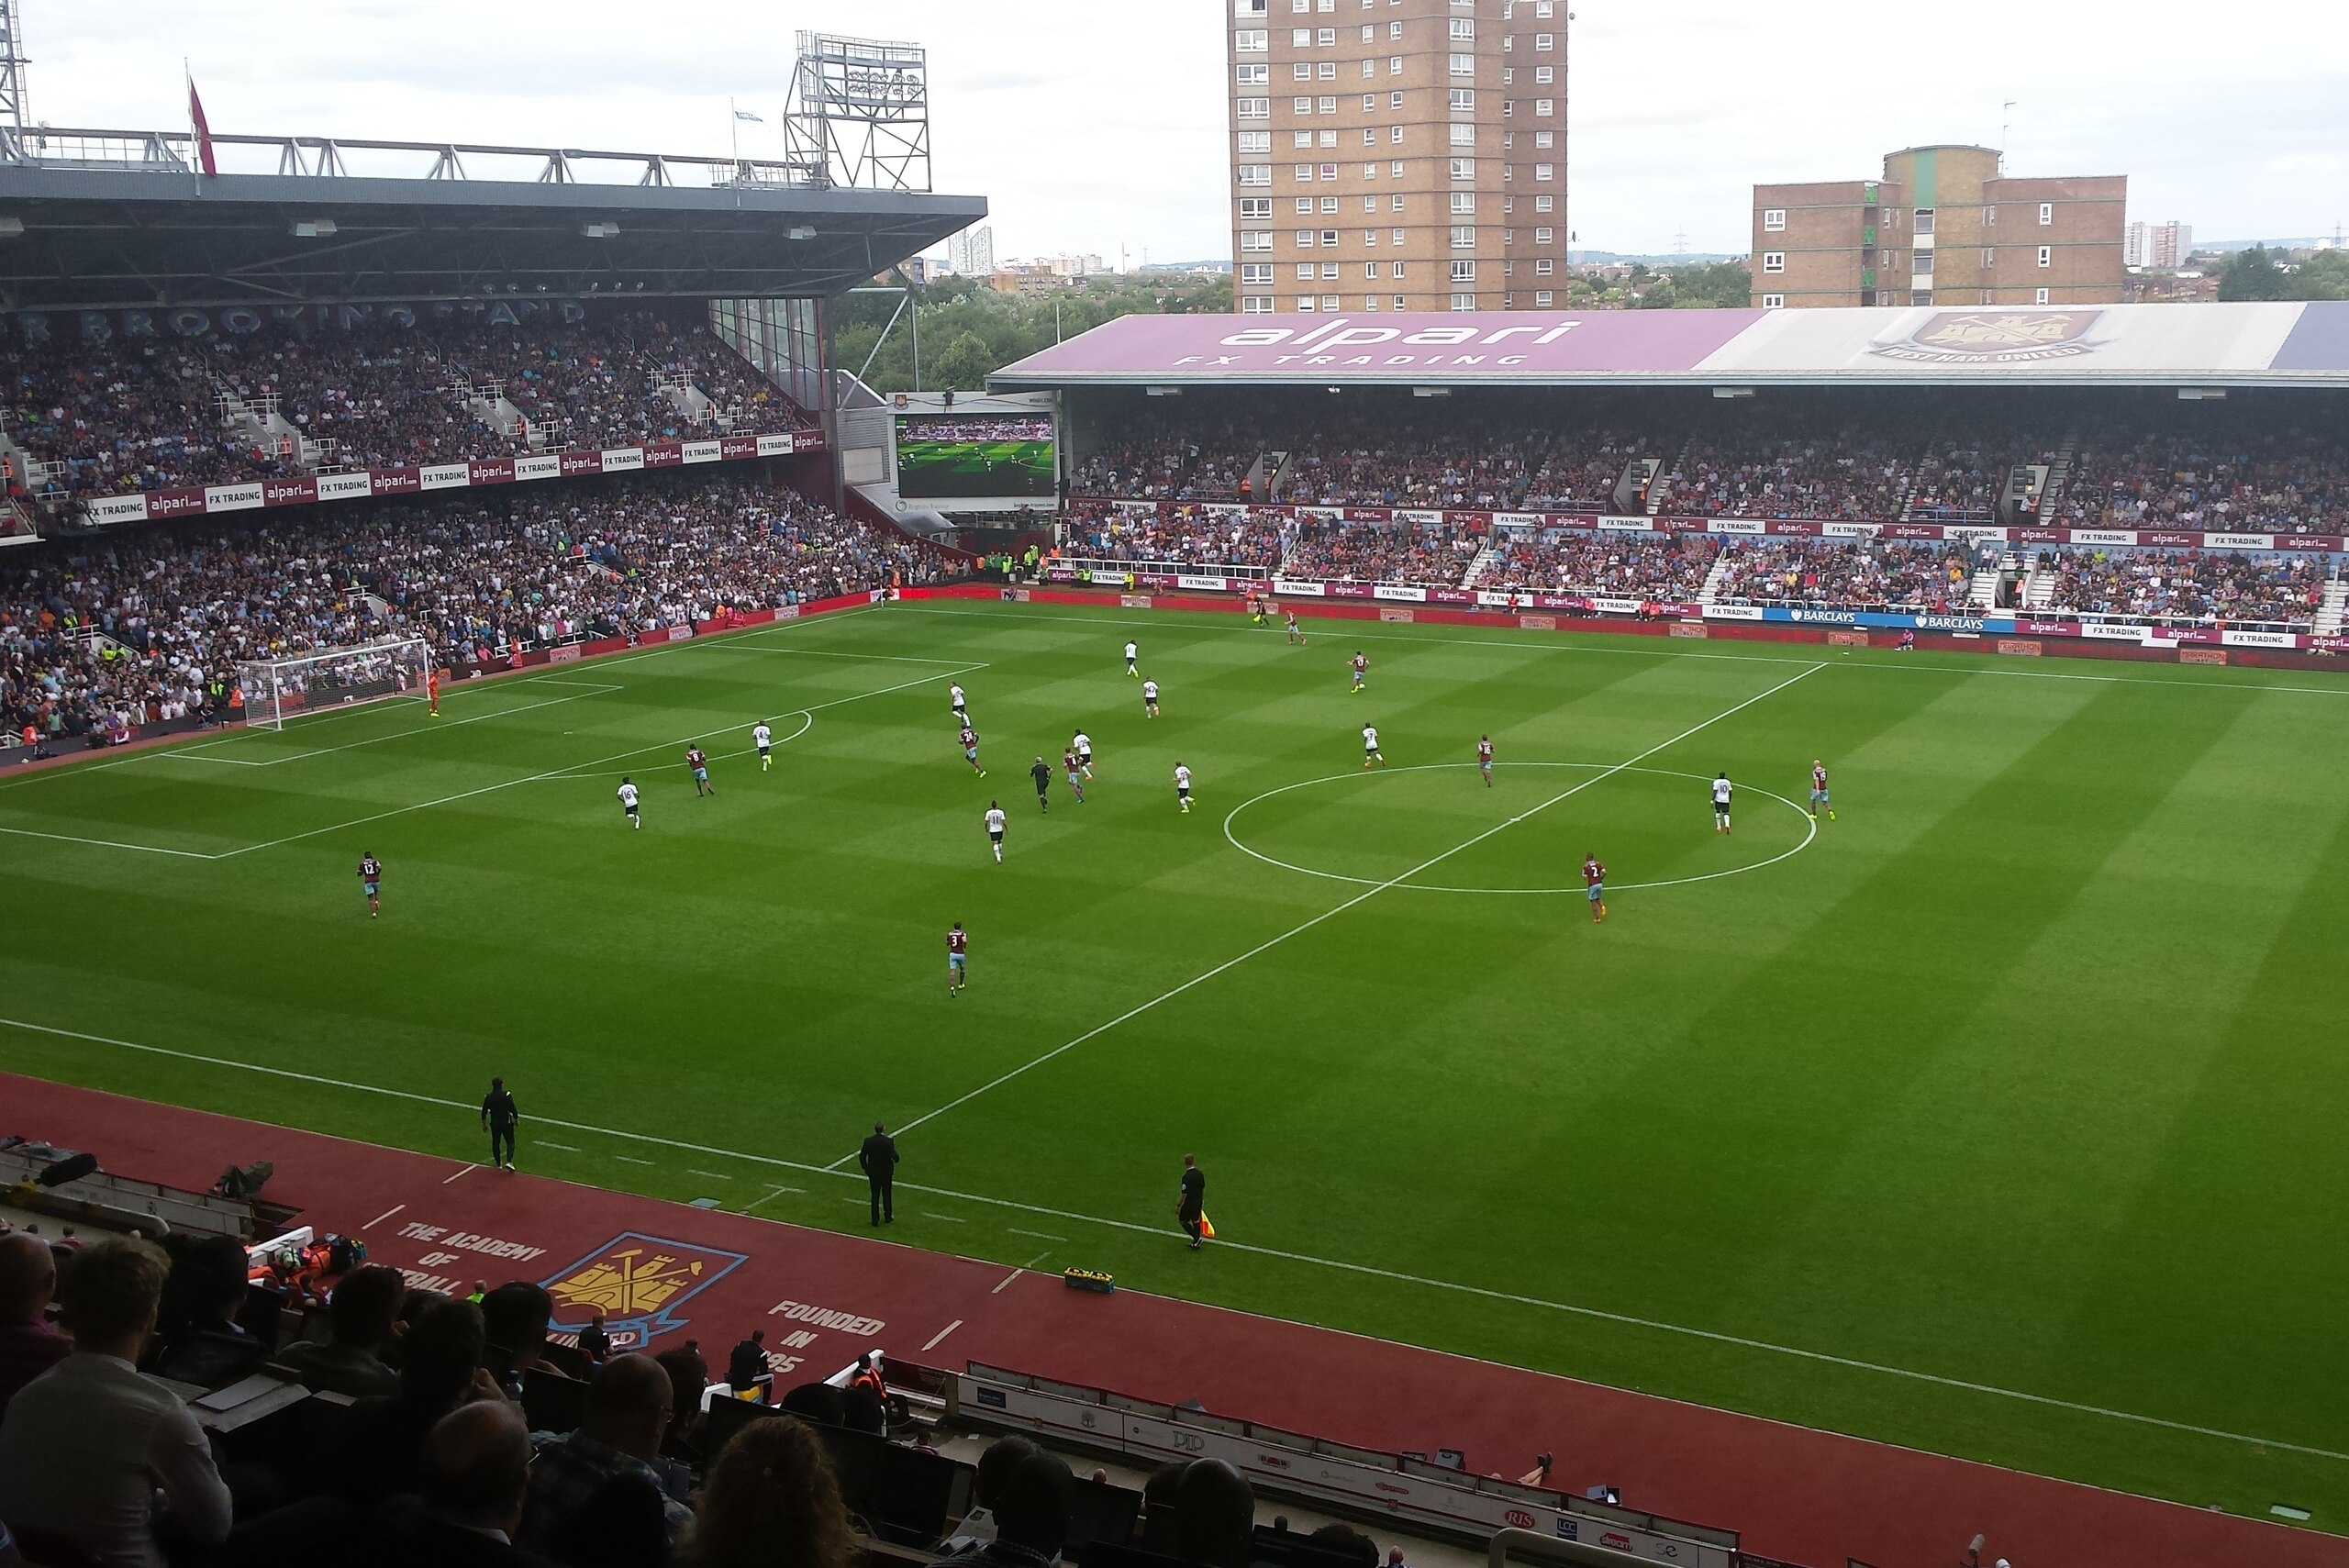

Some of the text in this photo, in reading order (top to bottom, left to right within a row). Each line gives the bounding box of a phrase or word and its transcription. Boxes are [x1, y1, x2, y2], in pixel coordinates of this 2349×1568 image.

[1219, 317, 1582, 355] alpari
[1881, 346, 2082, 363] WEST HAM UNITED
[1173, 354, 1530, 366] FX TRADING
[767, 439, 791, 450] TRADING
[694, 447, 719, 456] TRADING
[614, 454, 641, 464] TRADING
[529, 462, 558, 472] TRADING
[434, 471, 466, 481] TRADING
[320, 480, 368, 493] FX TRADING
[209, 491, 261, 505] FX TRADING
[103, 502, 143, 516] TRADING
[1965, 529, 1998, 538] TADING
[2093, 533, 2127, 541] TRADING
[2228, 538, 2263, 546] TRADING
[1195, 579, 1219, 587] TRADING
[1290, 584, 1317, 593] TRADING
[1391, 590, 1418, 598] TRADING
[1497, 595, 1525, 604] TRAG
[1721, 608, 1753, 617] TRADING
[1803, 610, 1855, 623] BARCLAYS
[1929, 617, 1984, 629] BARCLAYS
[2105, 627, 2141, 636] TRADING
[2233, 634, 2284, 644] FX TRADING
[2181, 651, 2227, 660] MARATHON
[1720, 784, 1728, 794] 10
[364, 864, 374, 874] 12
[1592, 867, 1598, 877] 2
[952, 936, 958, 947] 3
[397, 1222, 548, 1262] THE ACADEMY
[417, 1251, 461, 1267] OF
[767, 1299, 886, 1337] FOUNDED
[780, 1329, 819, 1349] IN
[1507, 1512, 1534, 1528] RIS
[1558, 1518, 1577, 1532] LCC
